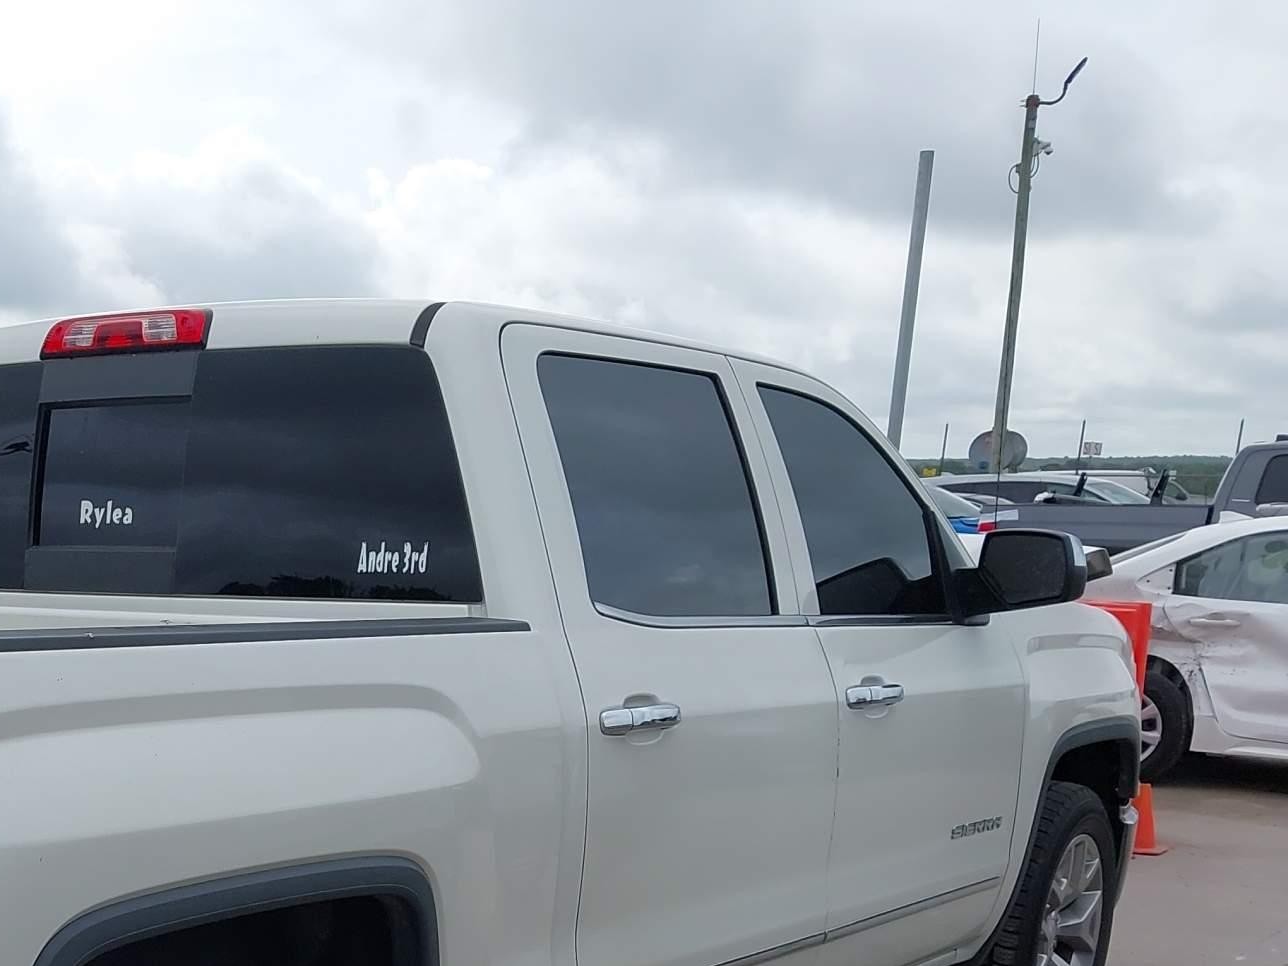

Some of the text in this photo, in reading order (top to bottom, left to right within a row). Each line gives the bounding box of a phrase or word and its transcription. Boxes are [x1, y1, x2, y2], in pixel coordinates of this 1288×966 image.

[79, 499, 133, 529] Rylea
[356, 541, 429, 574] Andre 3rd
